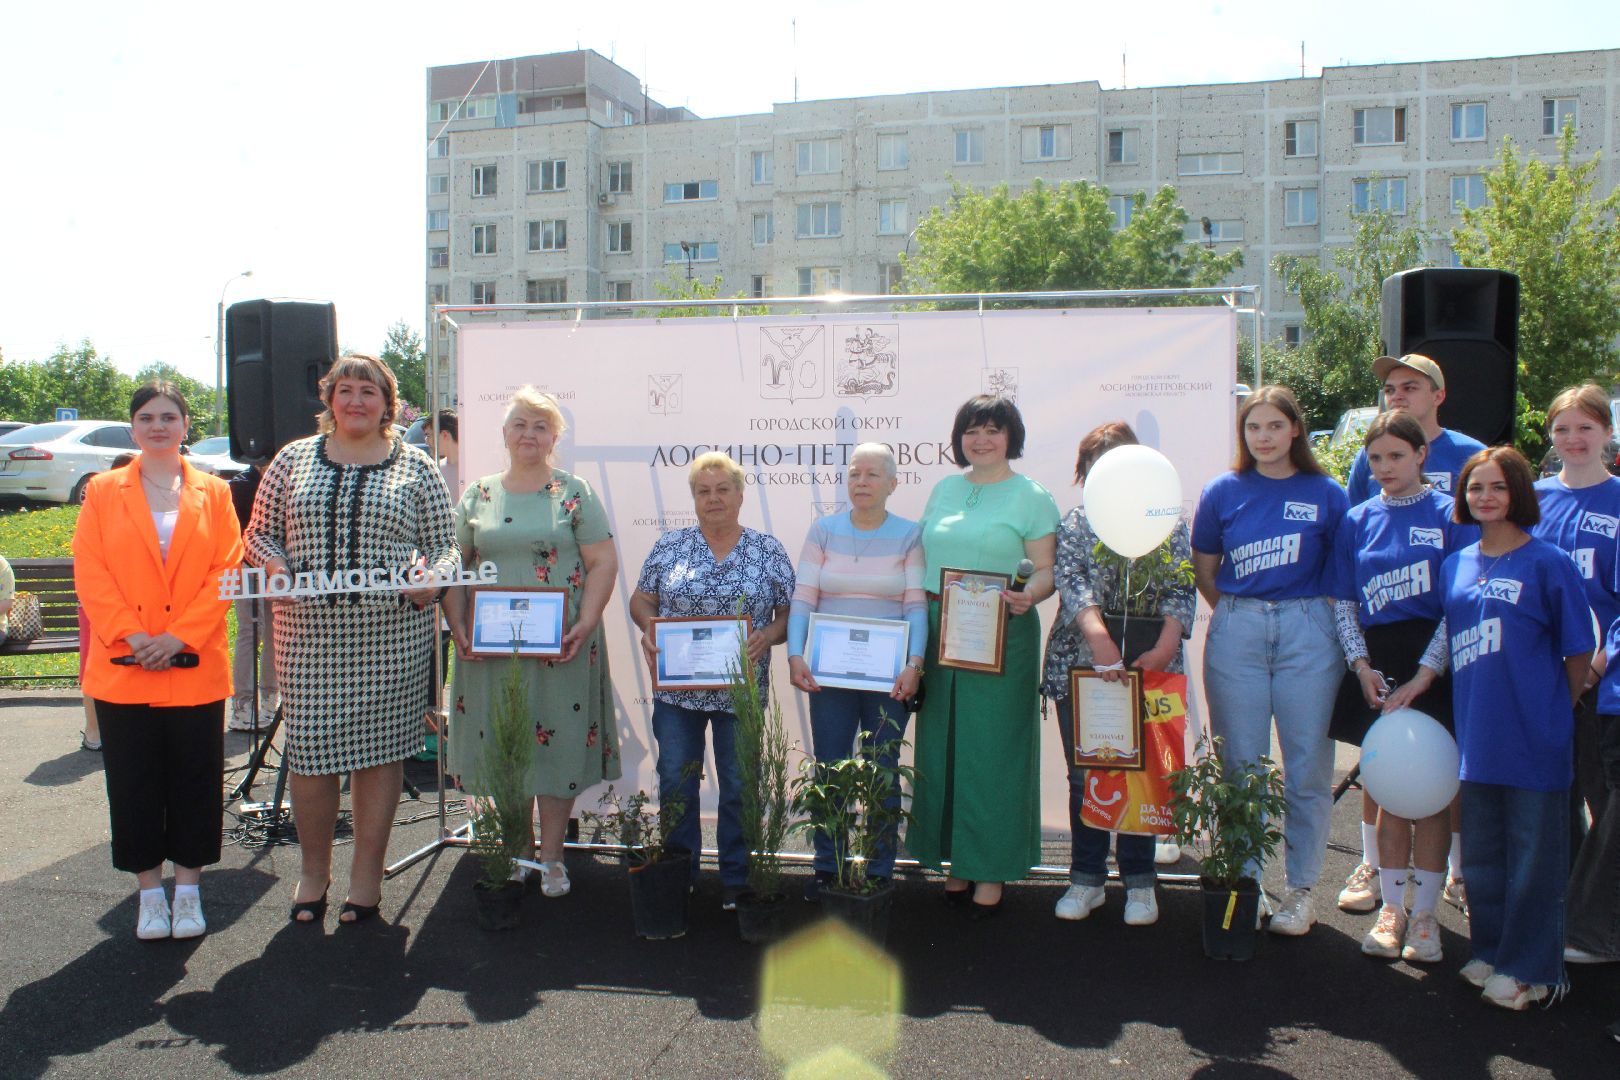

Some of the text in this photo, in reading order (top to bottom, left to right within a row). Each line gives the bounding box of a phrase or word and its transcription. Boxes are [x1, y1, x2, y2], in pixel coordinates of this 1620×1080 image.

[749, 415, 903, 430] ГОРОДСКОЙ ОКРУГ
[744, 471, 842, 486] ОСКОВСКАЯ
[1140, 803, 1159, 815] ДА,
